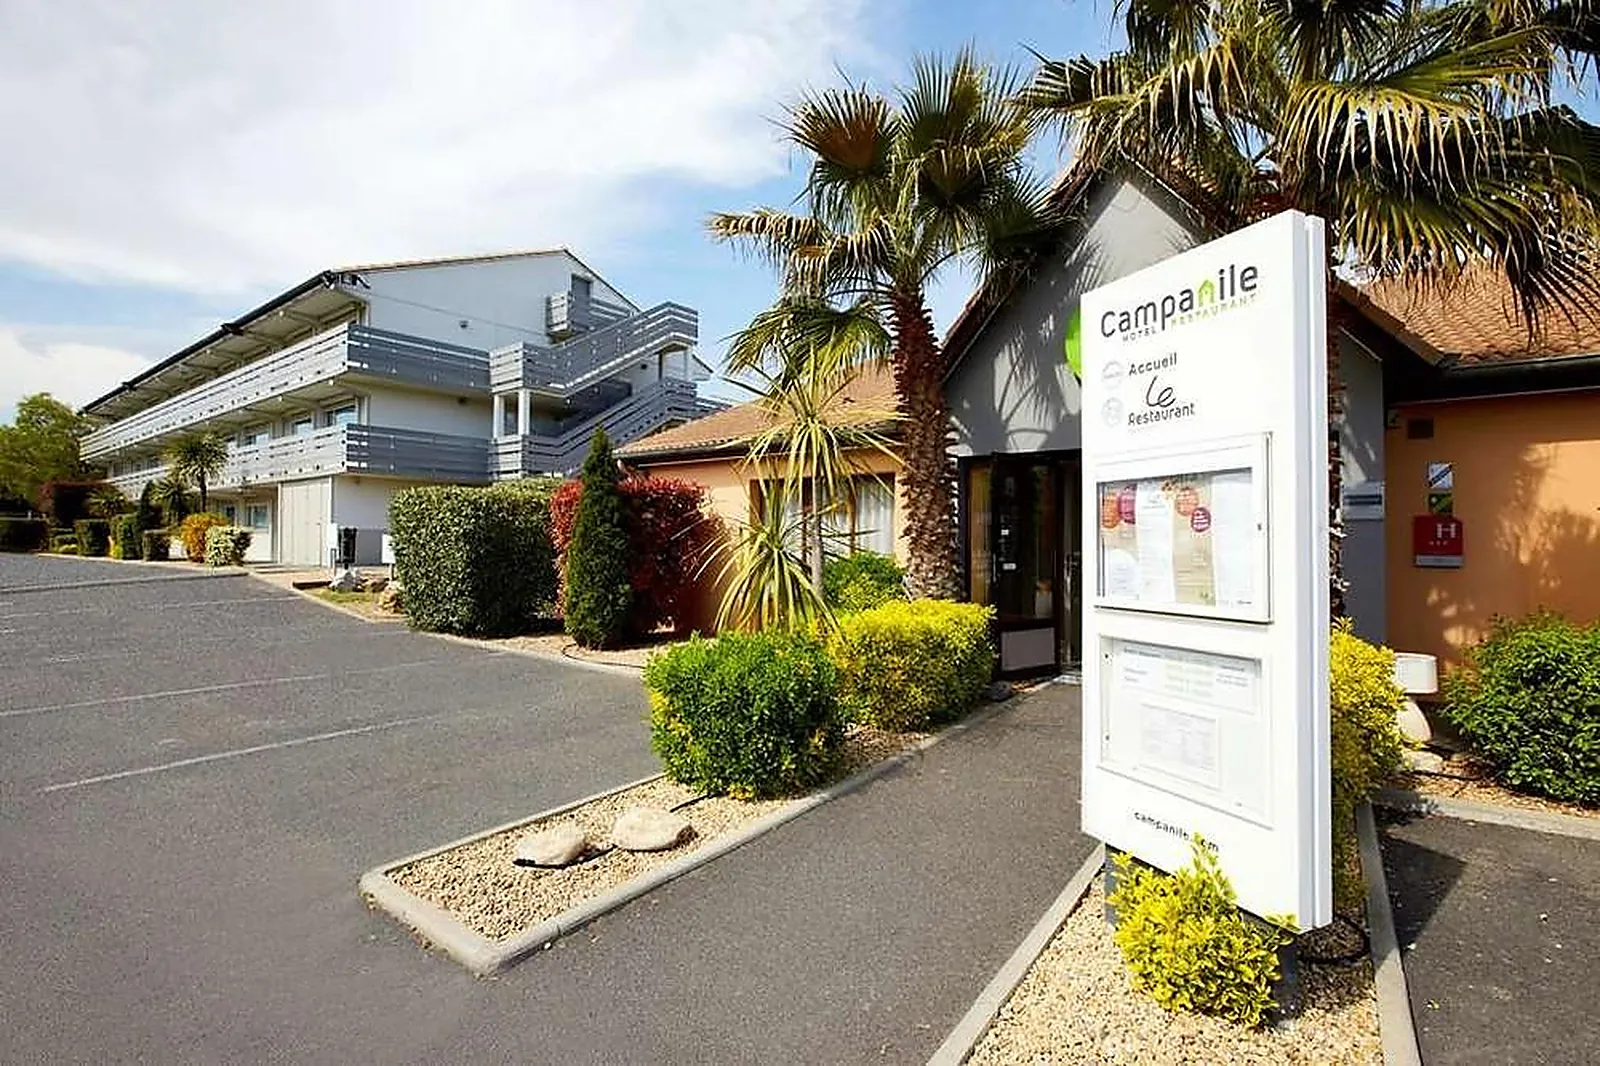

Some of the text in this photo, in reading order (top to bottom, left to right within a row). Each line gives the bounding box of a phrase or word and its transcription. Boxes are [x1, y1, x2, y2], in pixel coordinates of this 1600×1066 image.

[1101, 264, 1258, 338] Campanile
[1122, 294, 1256, 341] HOTEL RESTAURANT
[1129, 353, 1177, 376] Accueil
[1146, 376, 1176, 407] Le
[1128, 404, 1195, 426] Restaurant
[1437, 523, 1456, 538] H
[1134, 811, 1219, 852] campanile.om
